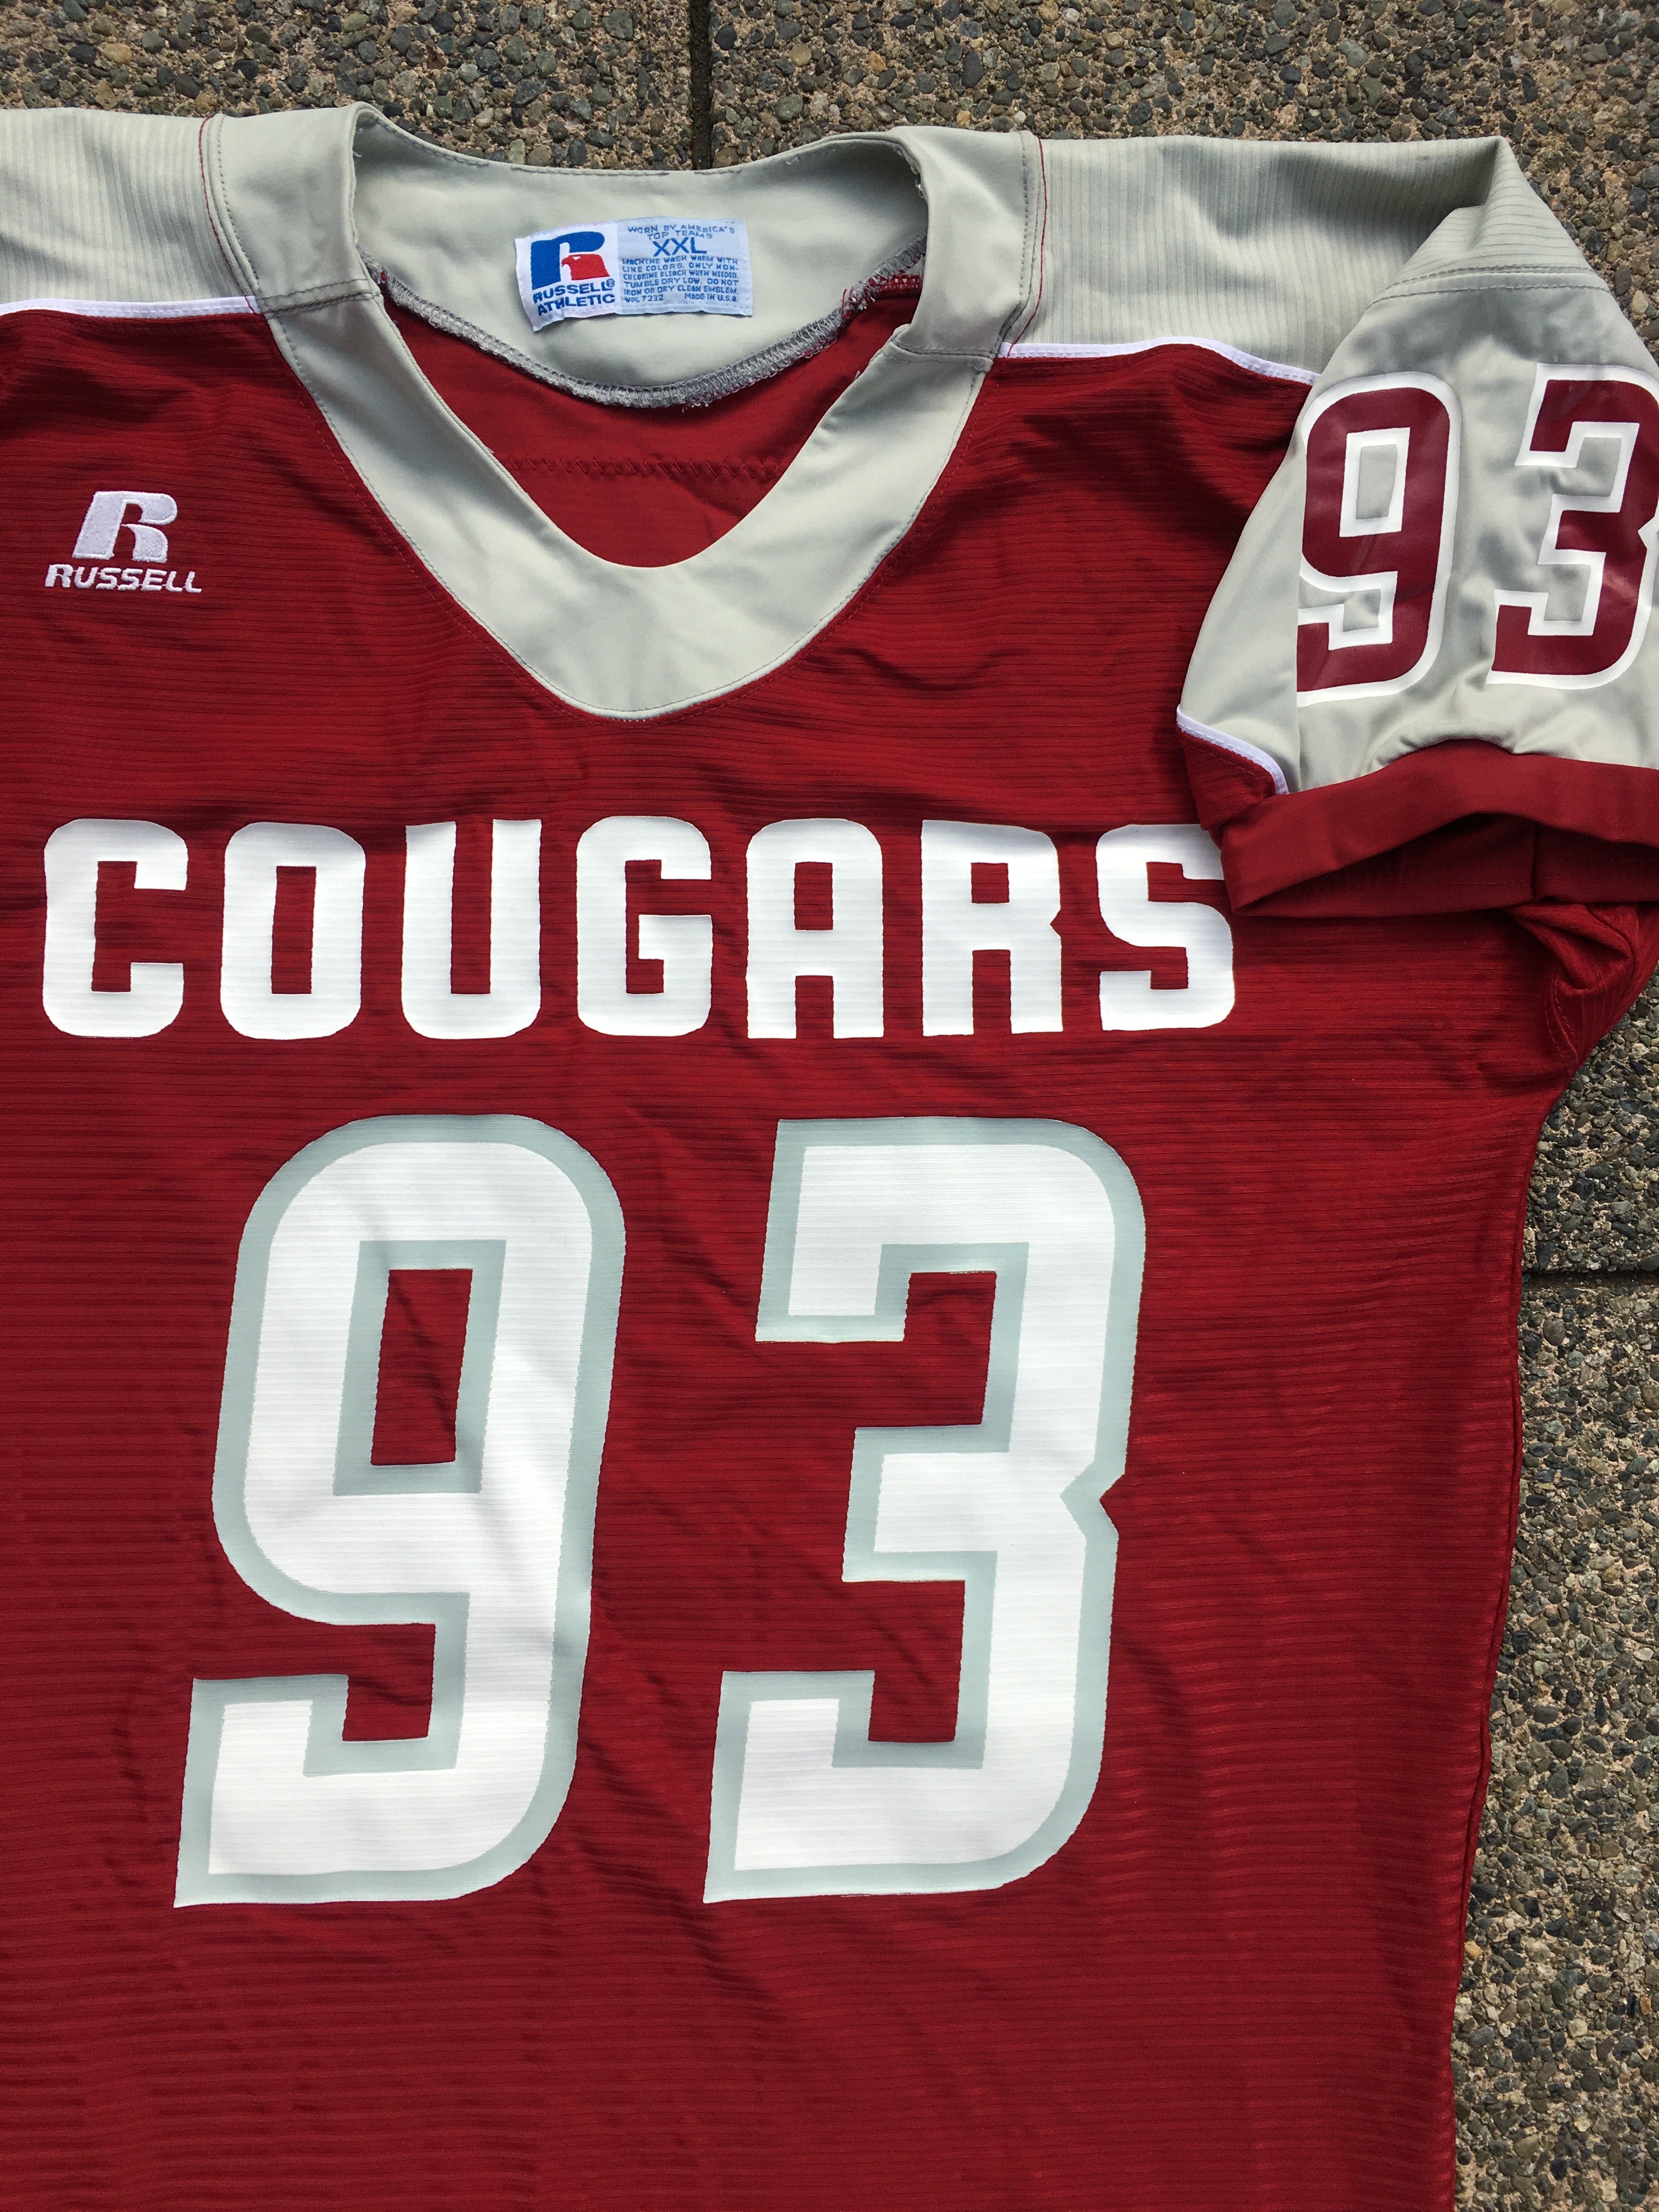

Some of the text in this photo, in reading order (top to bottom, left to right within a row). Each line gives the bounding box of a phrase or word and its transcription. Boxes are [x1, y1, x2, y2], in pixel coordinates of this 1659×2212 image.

[628, 225, 658, 234] WORN
[680, 224, 735, 234] AMERICA'S
[647, 230, 713, 240] TOP TEAMS
[652, 236, 707, 257] XXL
[664, 255, 687, 263] WASH
[716, 256, 738, 264] WITH
[646, 262, 685, 272] COLORS.
[623, 271, 658, 281] CHLORINE
[712, 270, 739, 279] NEEDED.
[624, 279, 659, 289] TUMBLE
[682, 276, 702, 285] LOW.
[657, 285, 675, 294] DRY
[678, 284, 701, 292] CLEAN
[703, 285, 739, 295] EMBLEM.
[707, 292, 715, 301] IN
[717, 294, 738, 303] U.S.A.
[538, 294, 616, 316] ATHLETIC
[1296, 363, 1659, 708] 93
[44, 563, 202, 594] RUSSELL
[42, 816, 1235, 1040] COUGARS
[173, 1114, 1147, 1907] 93
